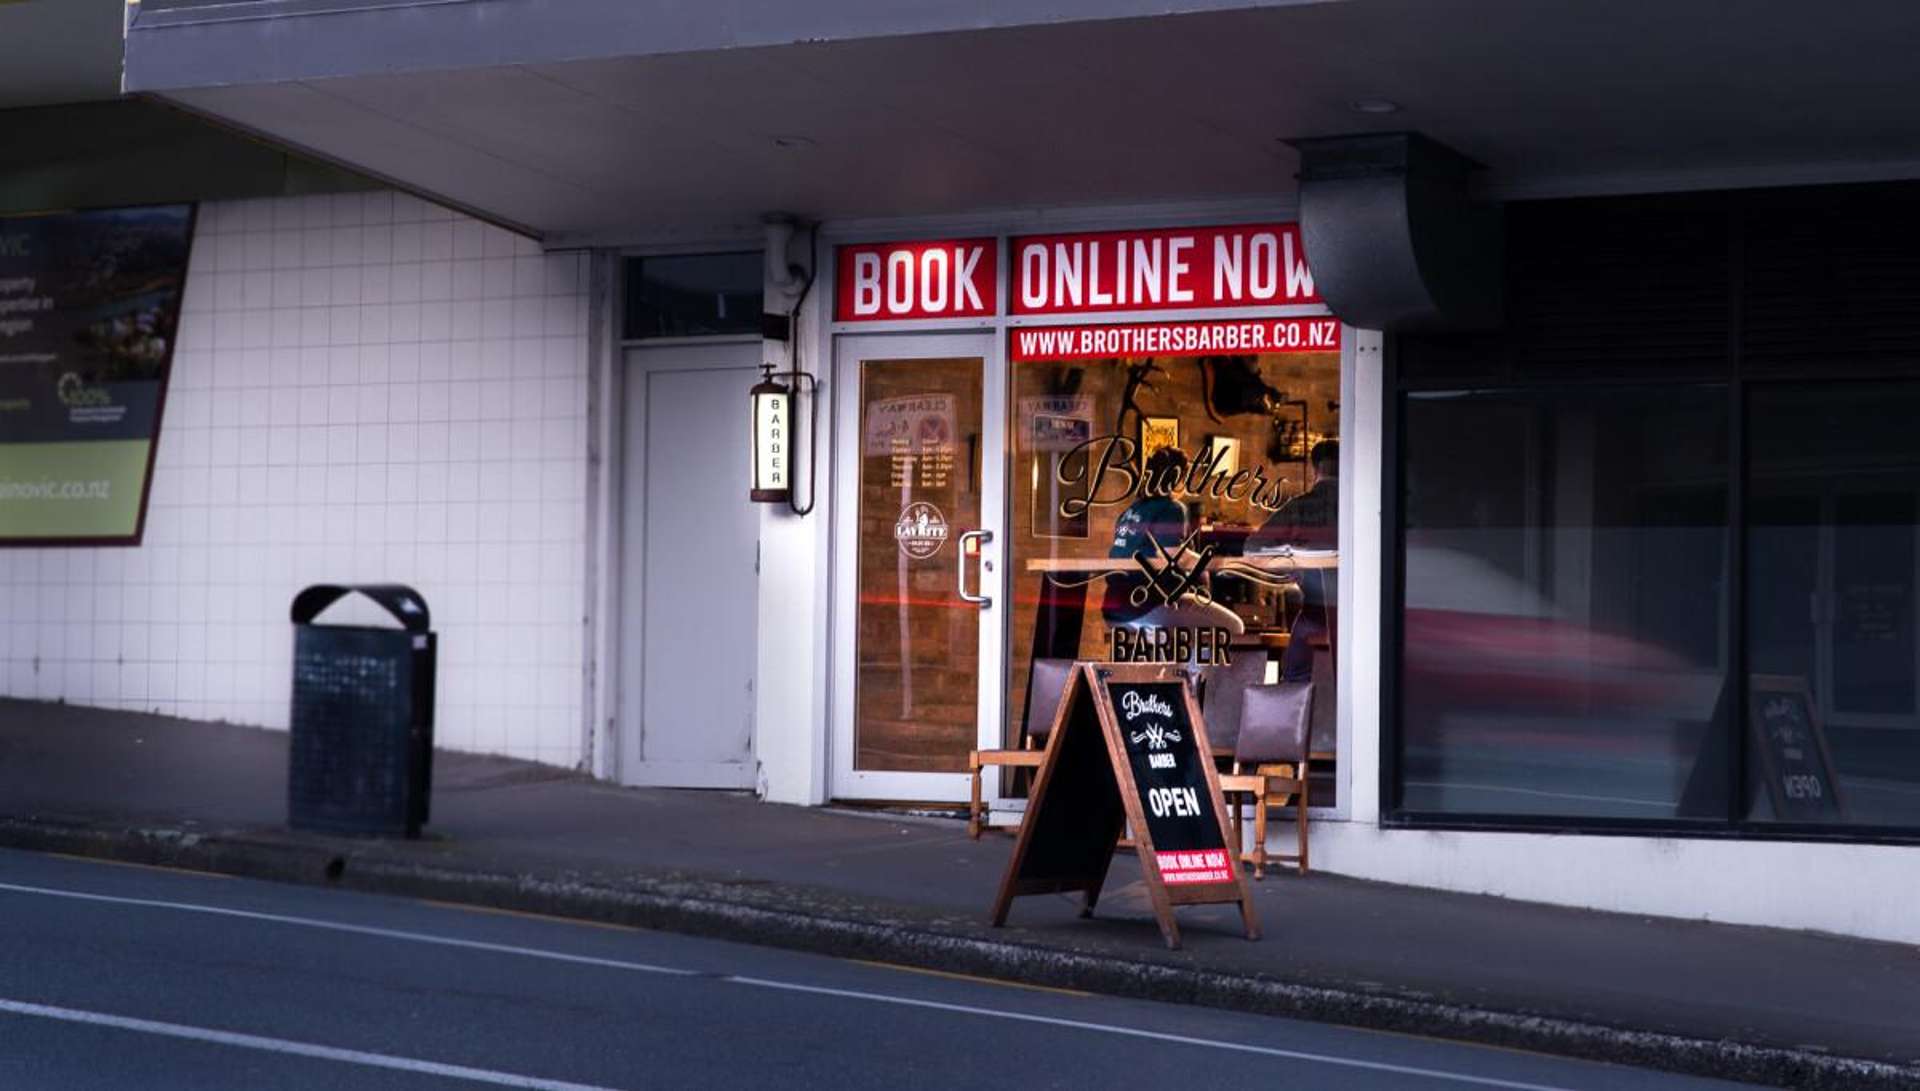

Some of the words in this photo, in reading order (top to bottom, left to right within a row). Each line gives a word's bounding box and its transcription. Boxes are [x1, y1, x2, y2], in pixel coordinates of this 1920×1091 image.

[854, 247, 984, 315] BOOK
[1021, 236, 1196, 309] ONLINE
[1213, 231, 1315, 301] NOW
[1020, 321, 1337, 356] WWW.BROTHERSBARBER.CO.NZ
[770, 398, 781, 484] BARBER
[1056, 434, 1291, 518] Brothers
[1111, 626, 1233, 666] BARBER
[1122, 690, 1174, 720] Brothers
[1148, 786, 1202, 818] OPEN
